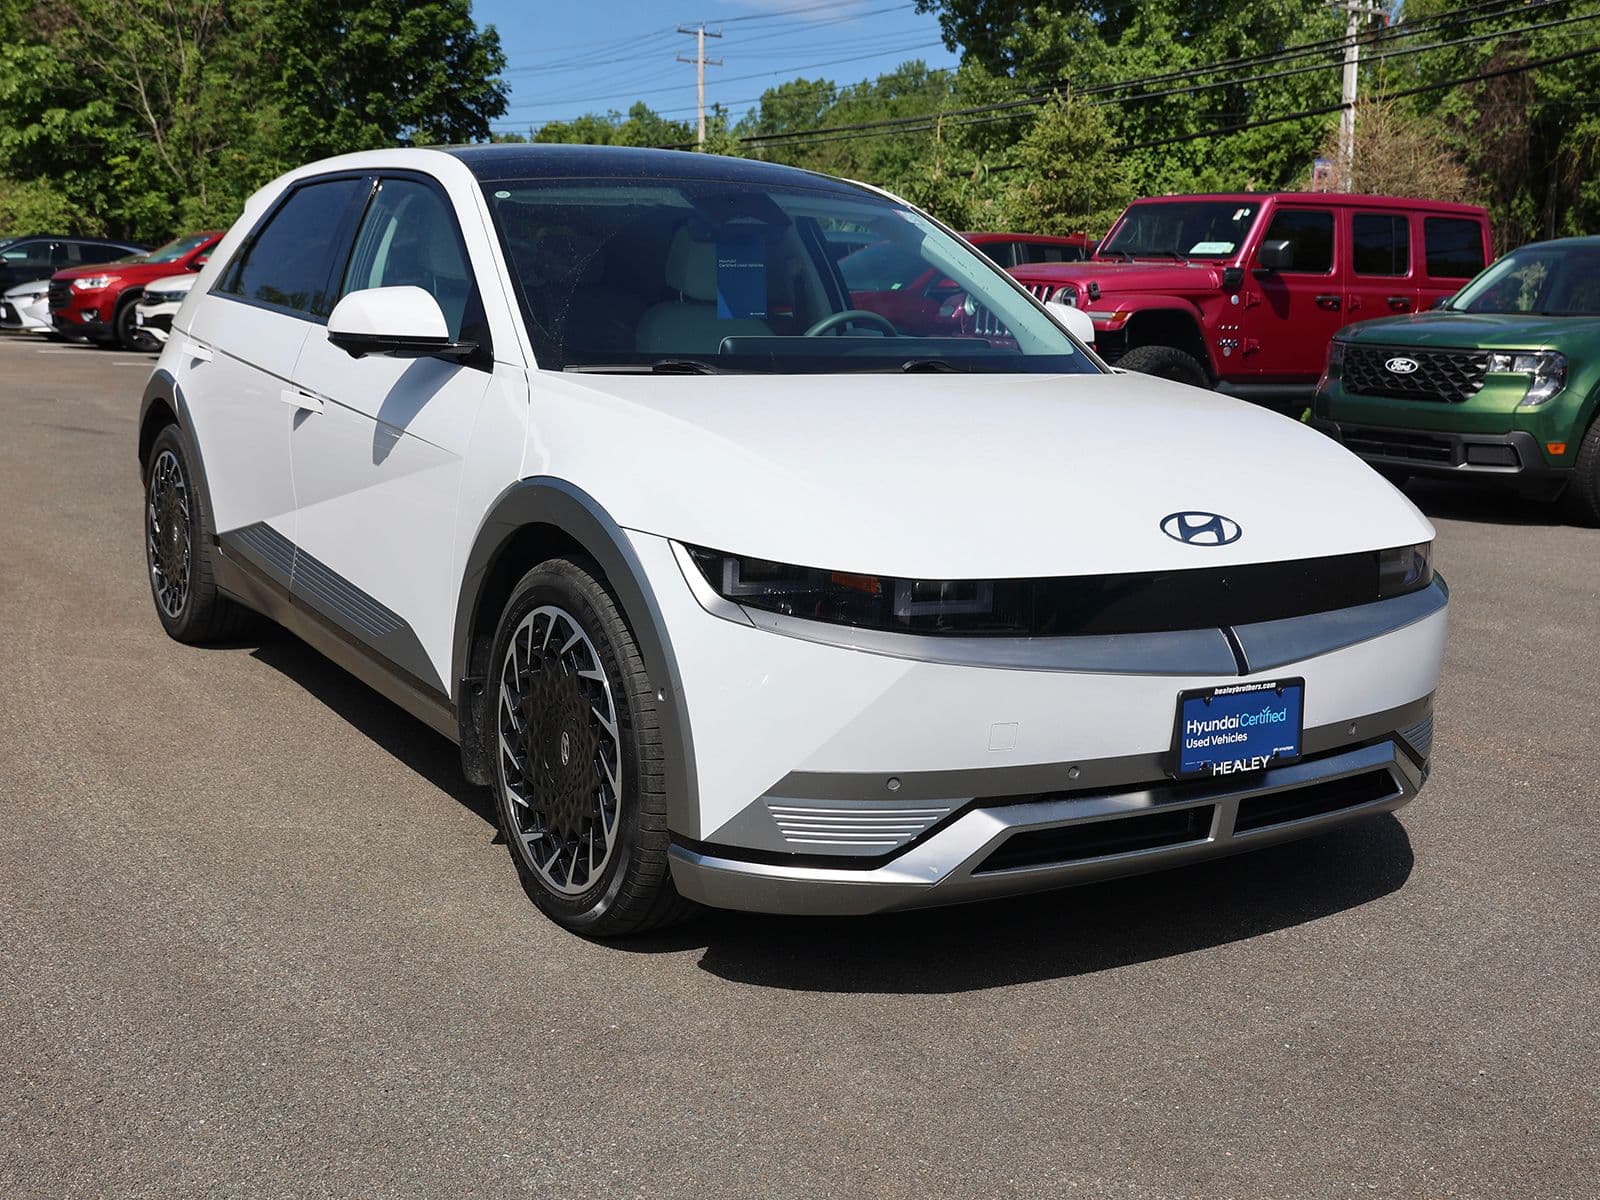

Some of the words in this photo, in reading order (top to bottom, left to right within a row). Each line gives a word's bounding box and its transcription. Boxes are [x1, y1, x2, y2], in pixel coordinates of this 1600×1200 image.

[1214, 682, 1277, 695] healeybrothers.com
[1186, 714, 1240, 736] Hyundai
[1240, 706, 1287, 727] Certified
[1186, 736, 1210, 749] Used
[1211, 732, 1248, 746] Vehicles
[1213, 755, 1270, 776] HEALEY
